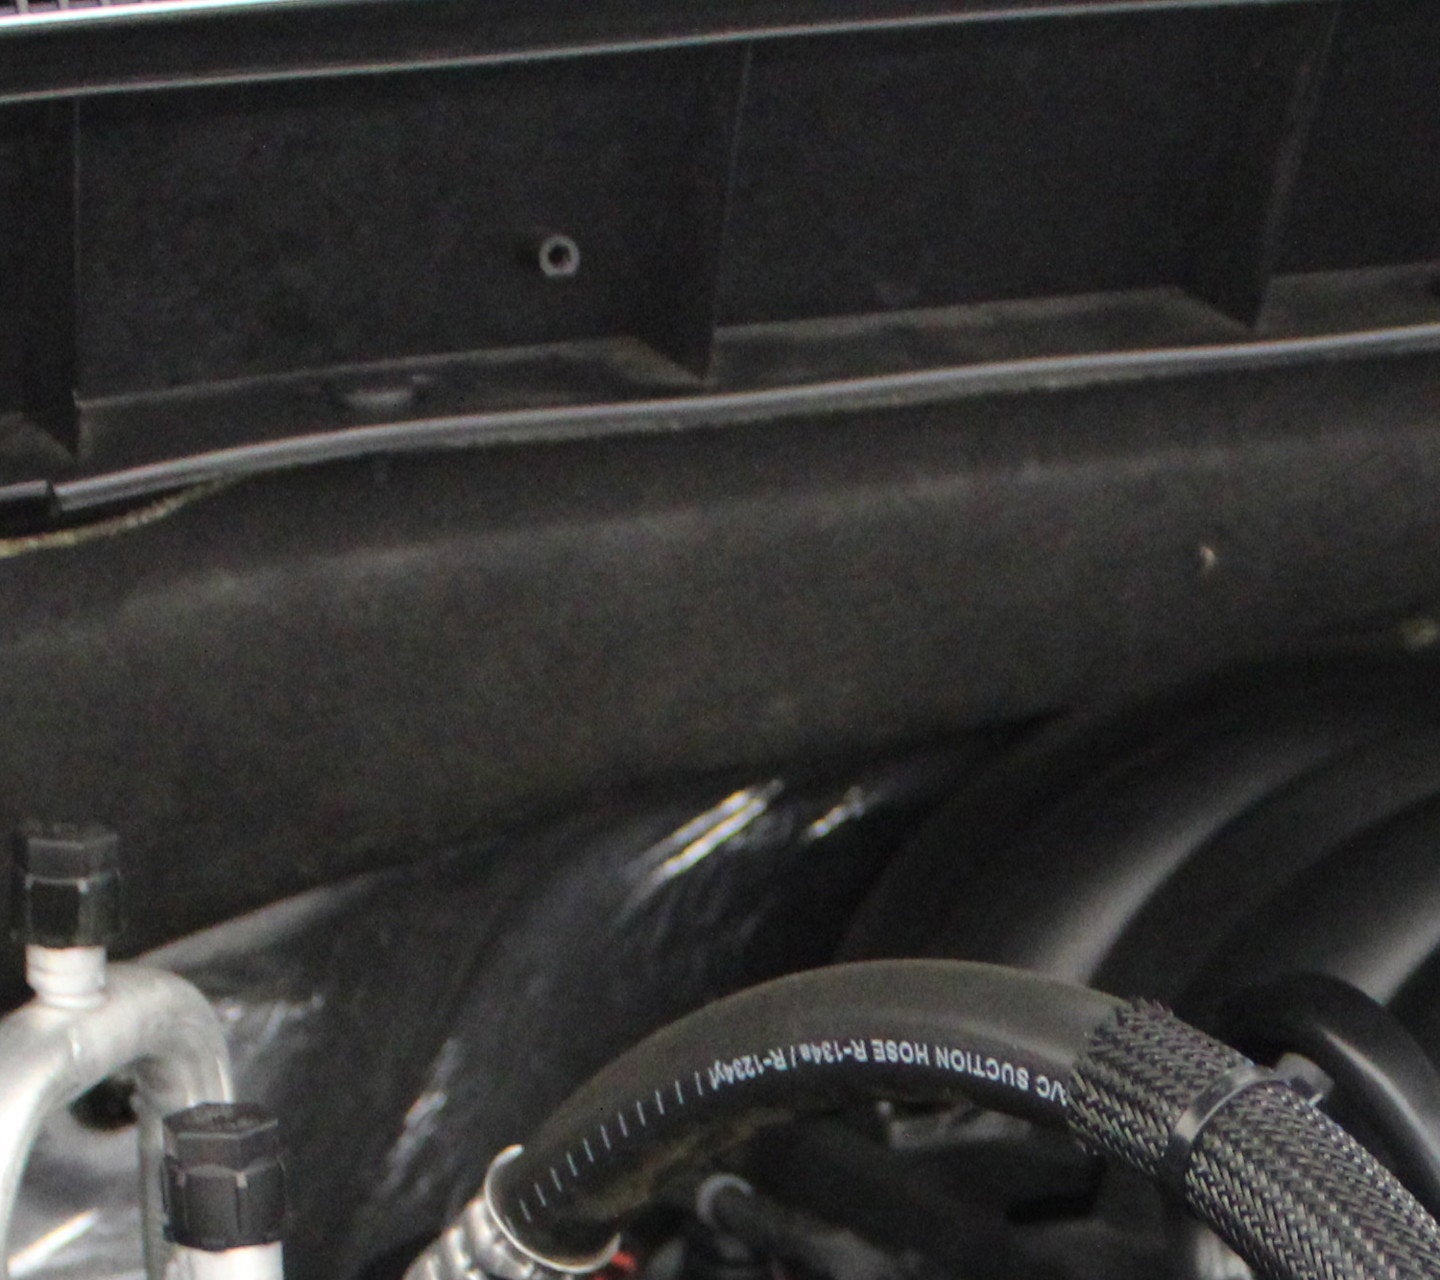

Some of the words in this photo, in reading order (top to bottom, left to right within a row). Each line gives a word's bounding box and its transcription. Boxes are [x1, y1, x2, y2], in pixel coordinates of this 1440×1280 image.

[799, 1039, 869, 1065] R-134a
[870, 1038, 930, 1066] HOSE
[936, 1046, 1030, 1092] SUCTION
